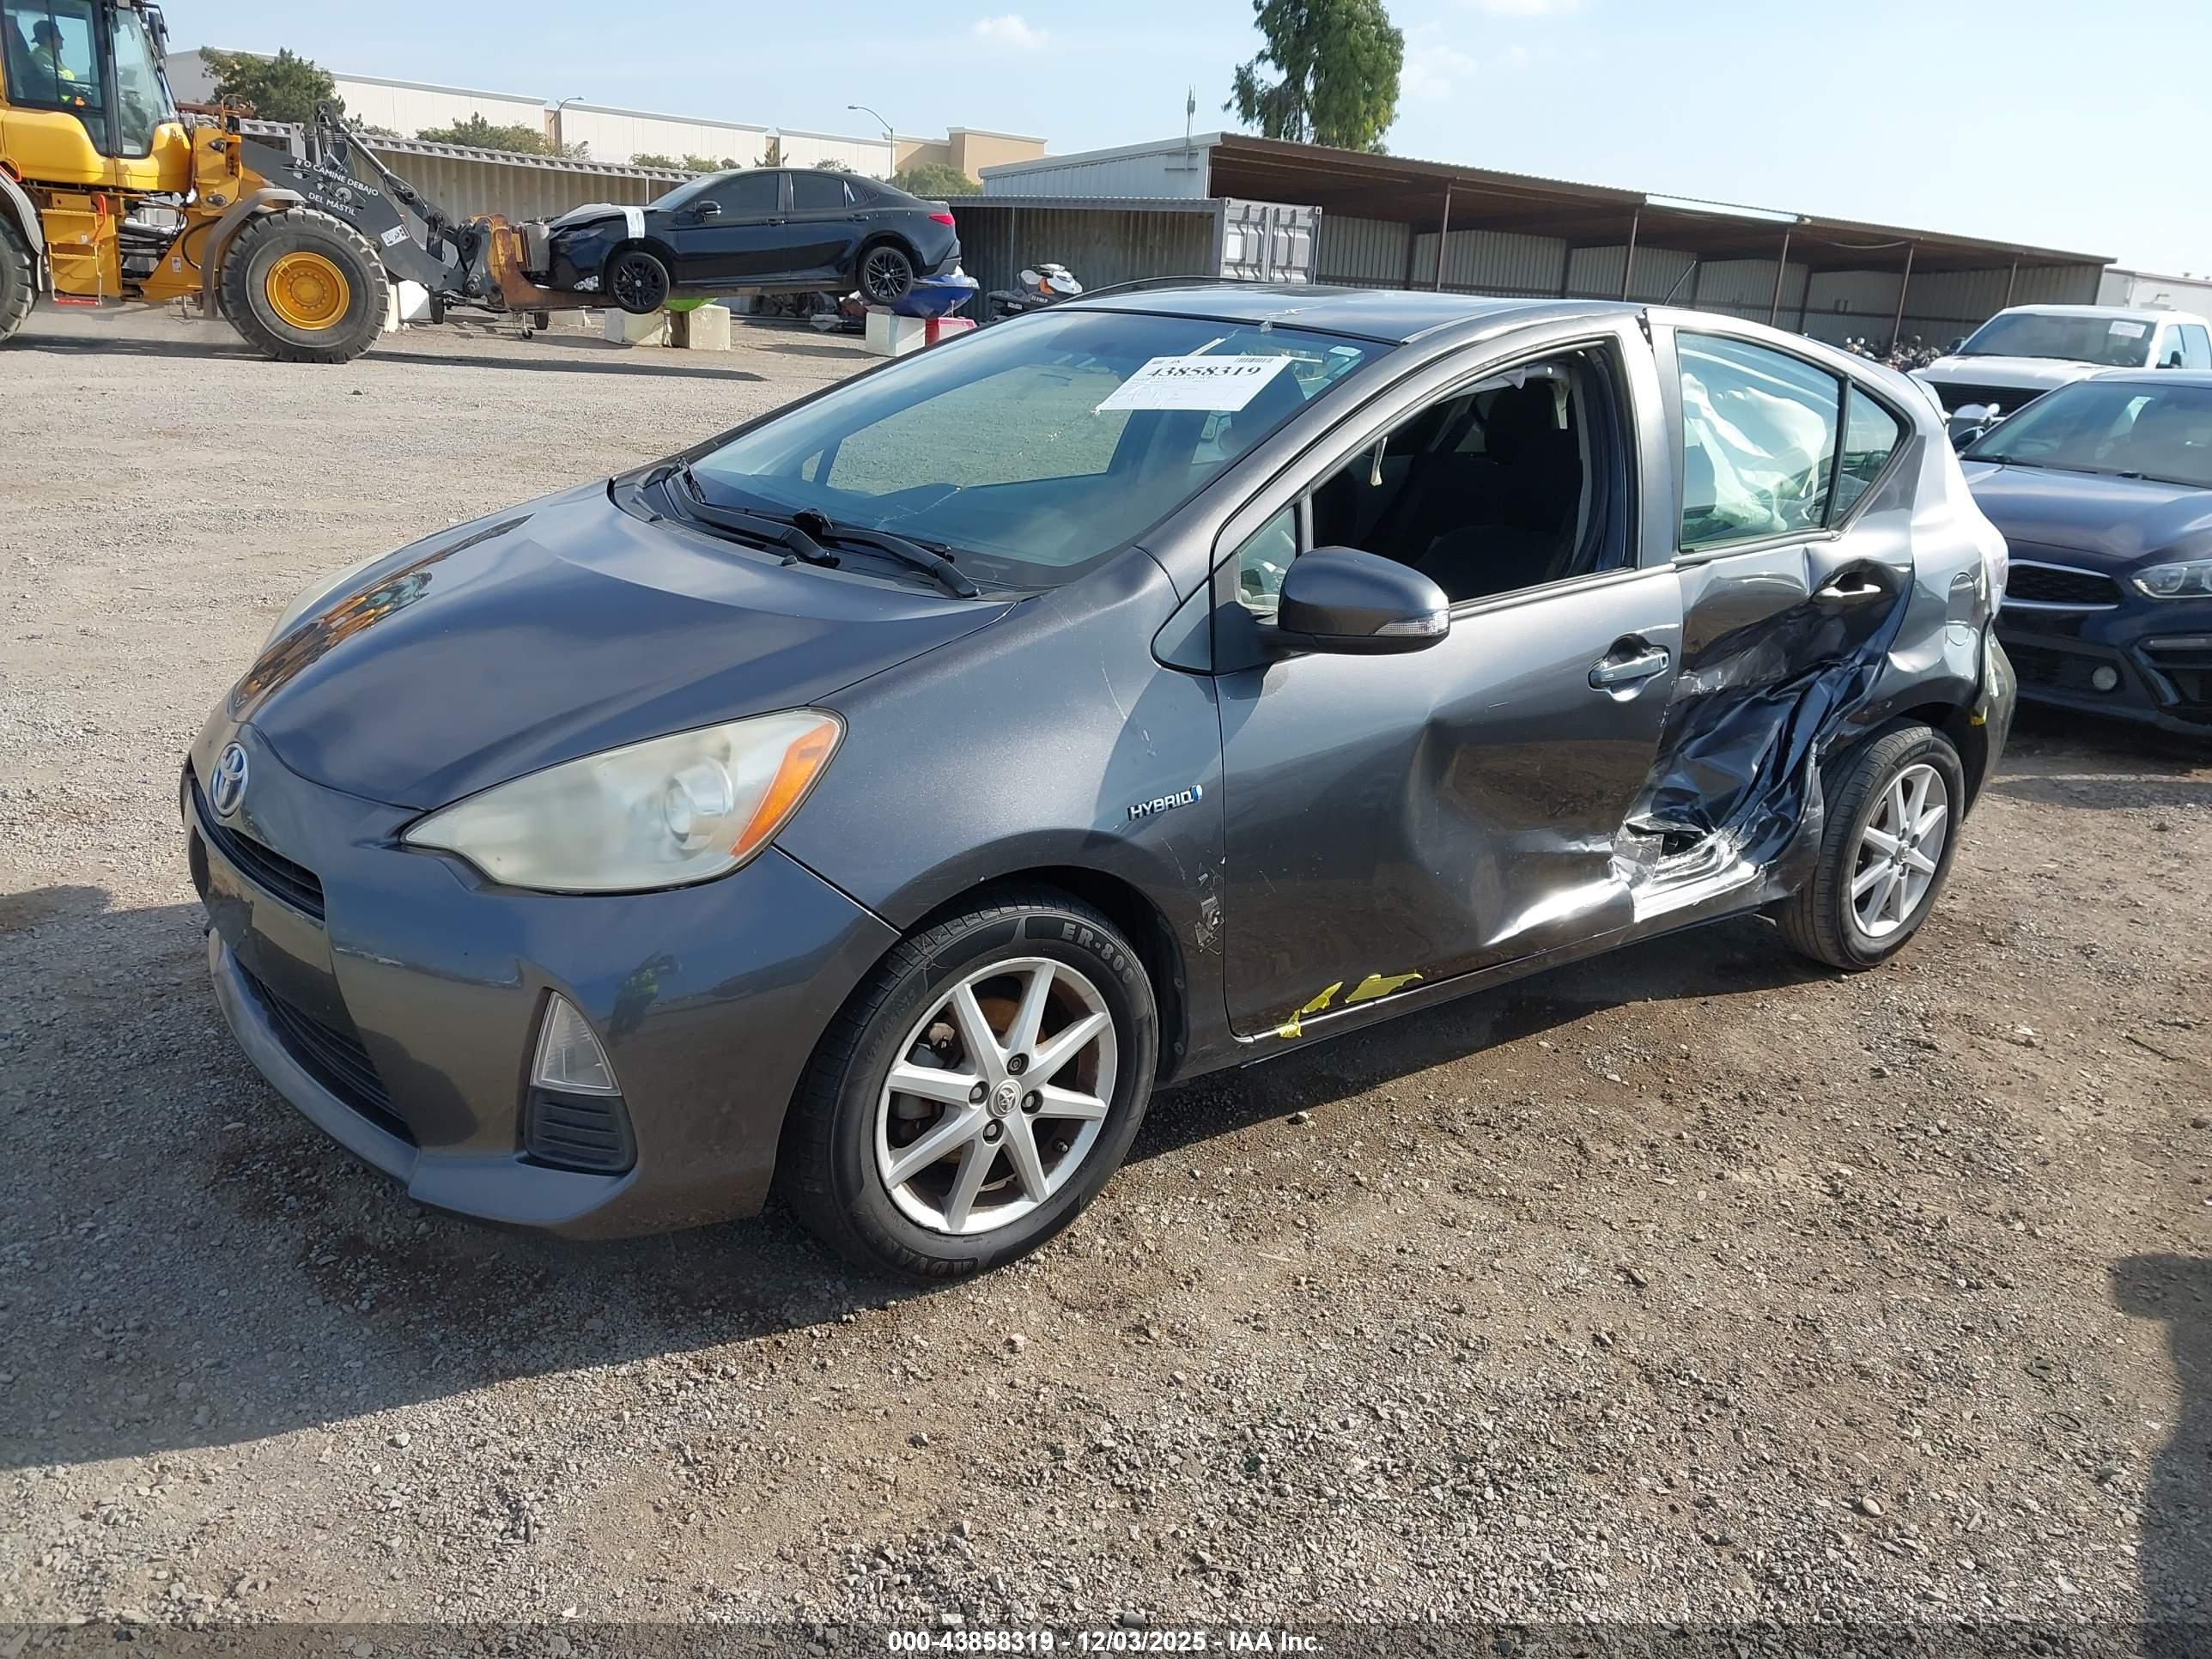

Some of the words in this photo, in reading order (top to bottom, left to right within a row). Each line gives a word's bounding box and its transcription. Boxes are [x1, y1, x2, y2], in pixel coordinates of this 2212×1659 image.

[313, 164, 345, 182] CAMINE
[347, 178, 379, 196] DEBAJO
[308, 191, 324, 204] DEL
[326, 198, 356, 216] MÁSTIL
[1146, 366, 1262, 377] 43858319
[1127, 790, 1194, 821] HYBRID
